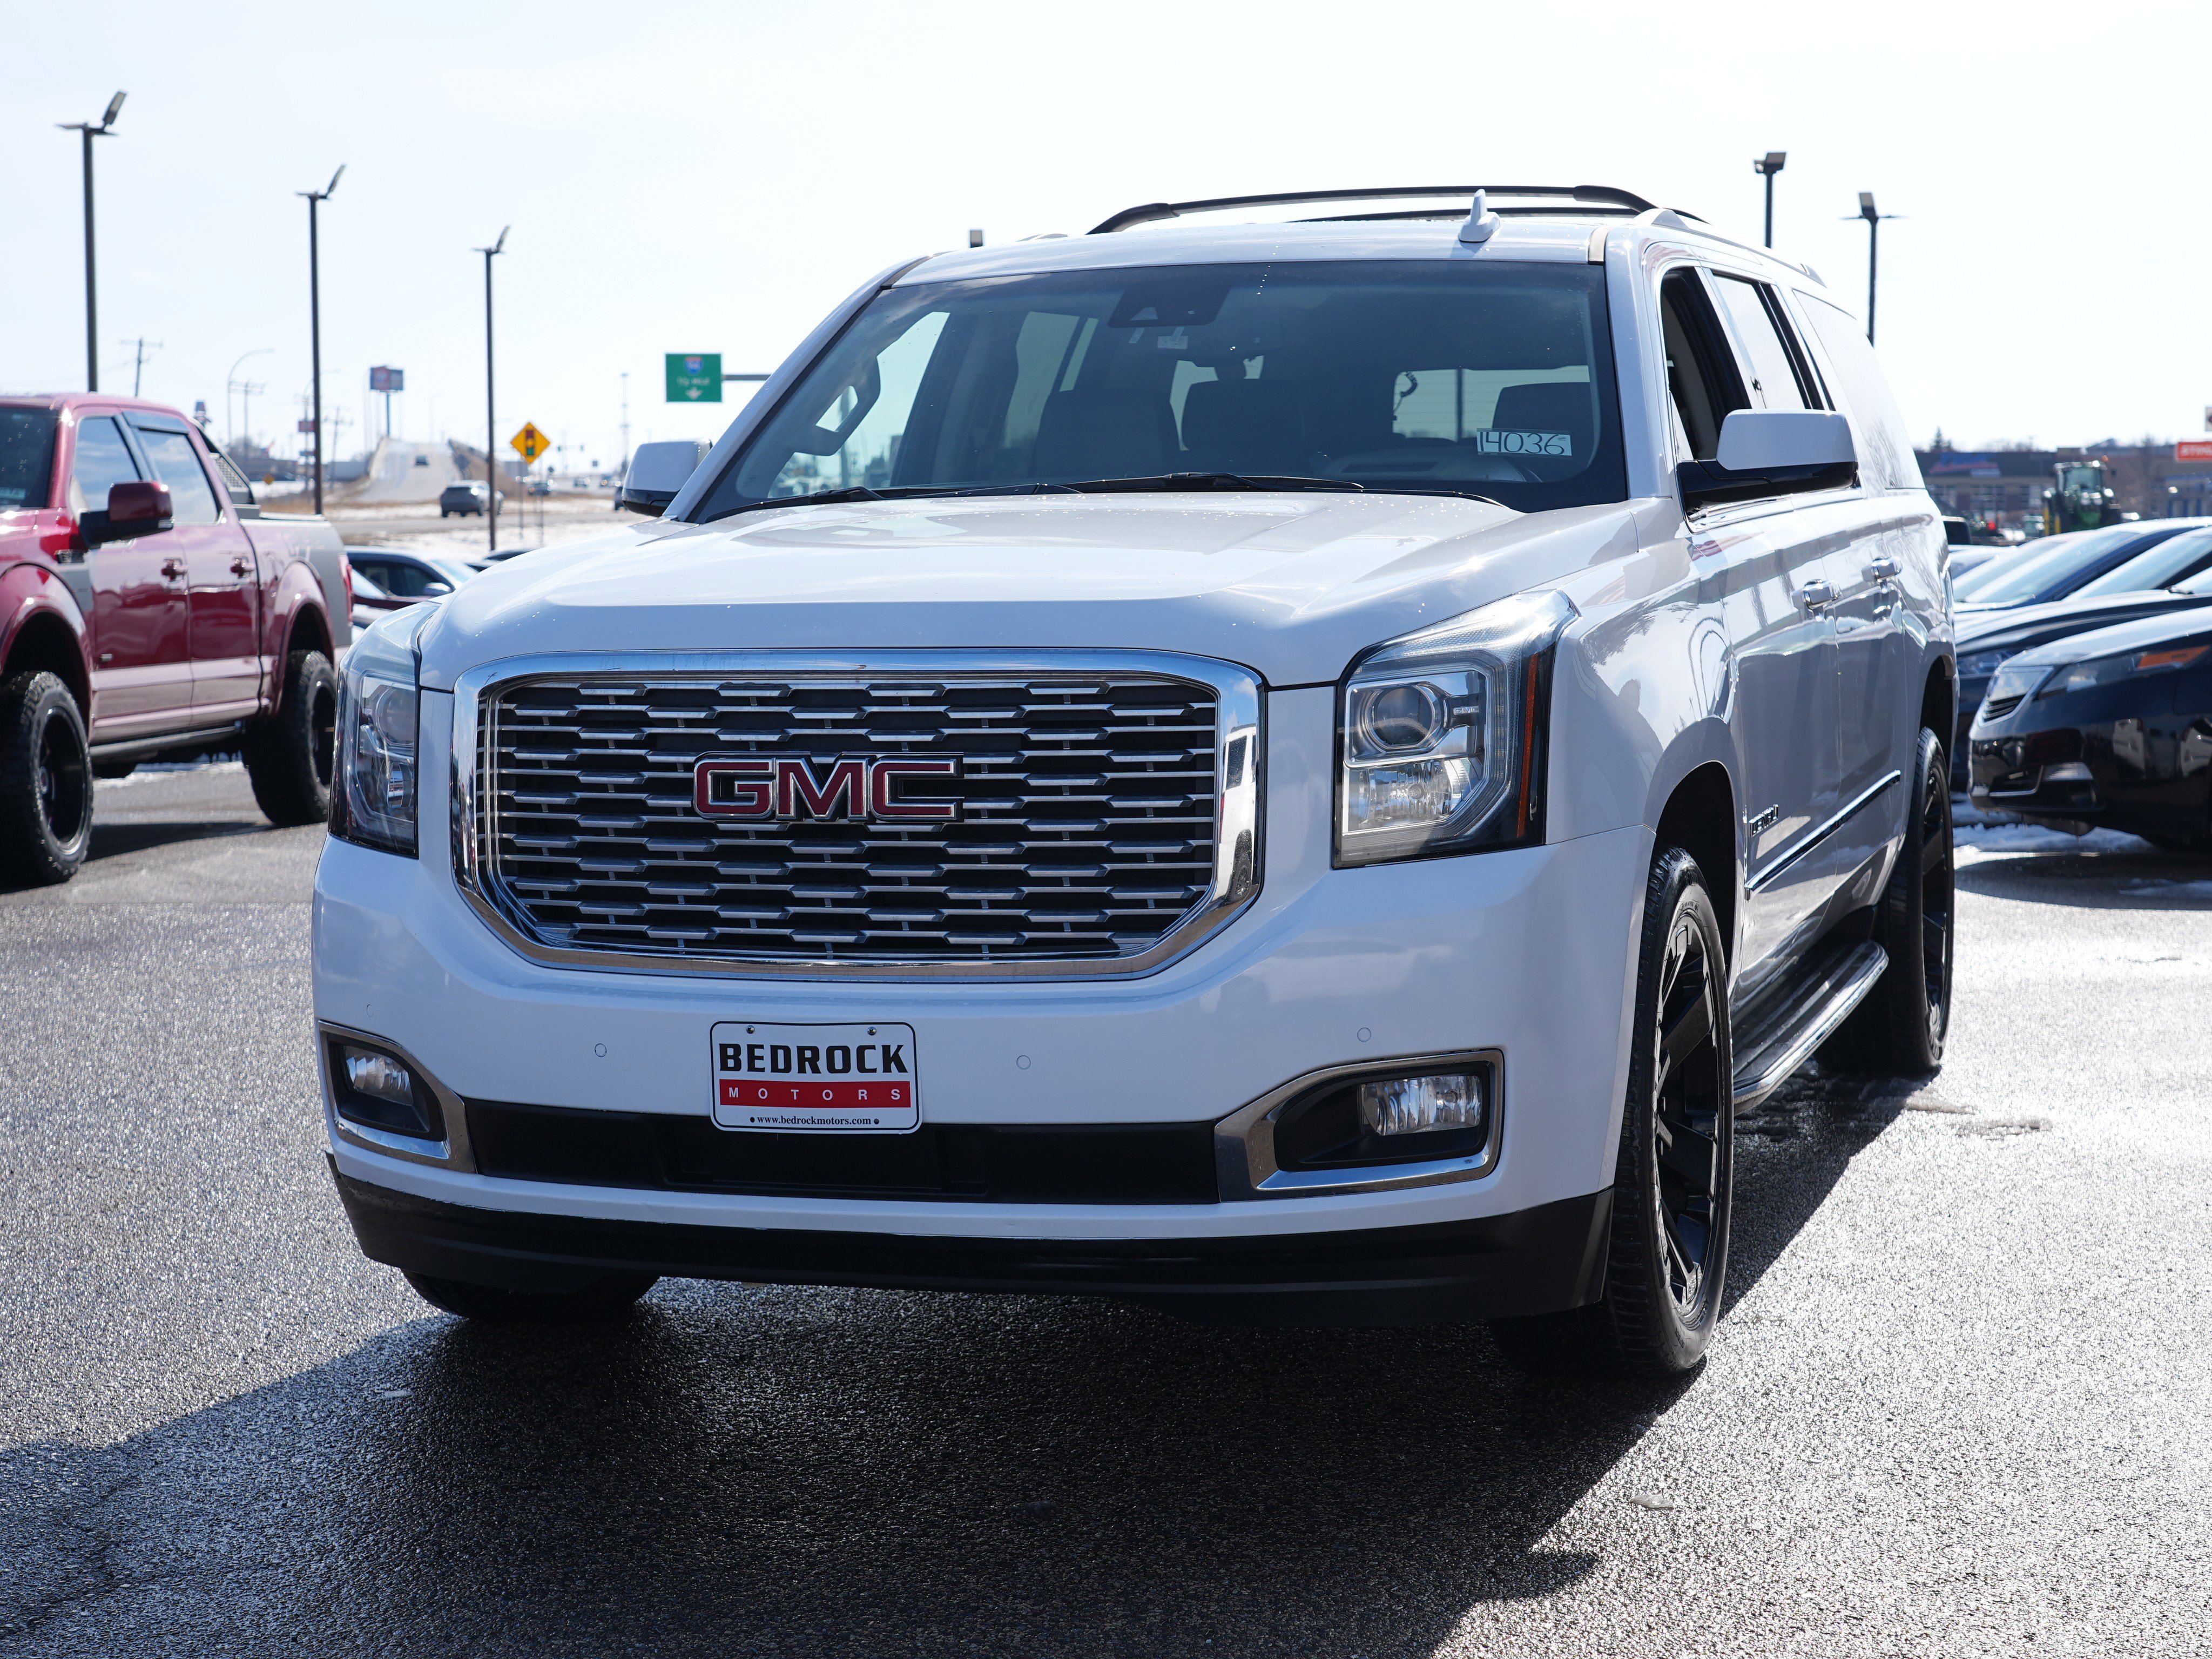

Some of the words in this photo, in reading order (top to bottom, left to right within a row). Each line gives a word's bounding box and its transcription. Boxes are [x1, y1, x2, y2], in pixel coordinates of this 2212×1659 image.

[1480, 431, 1565, 455] 14036
[1453, 706, 1479, 715] GMC
[693, 757, 957, 820] GMC
[719, 1043, 908, 1074] BEDROCK
[729, 1087, 901, 1101] MOTORS
[757, 1116, 871, 1125] www.bedrockmotors.com
